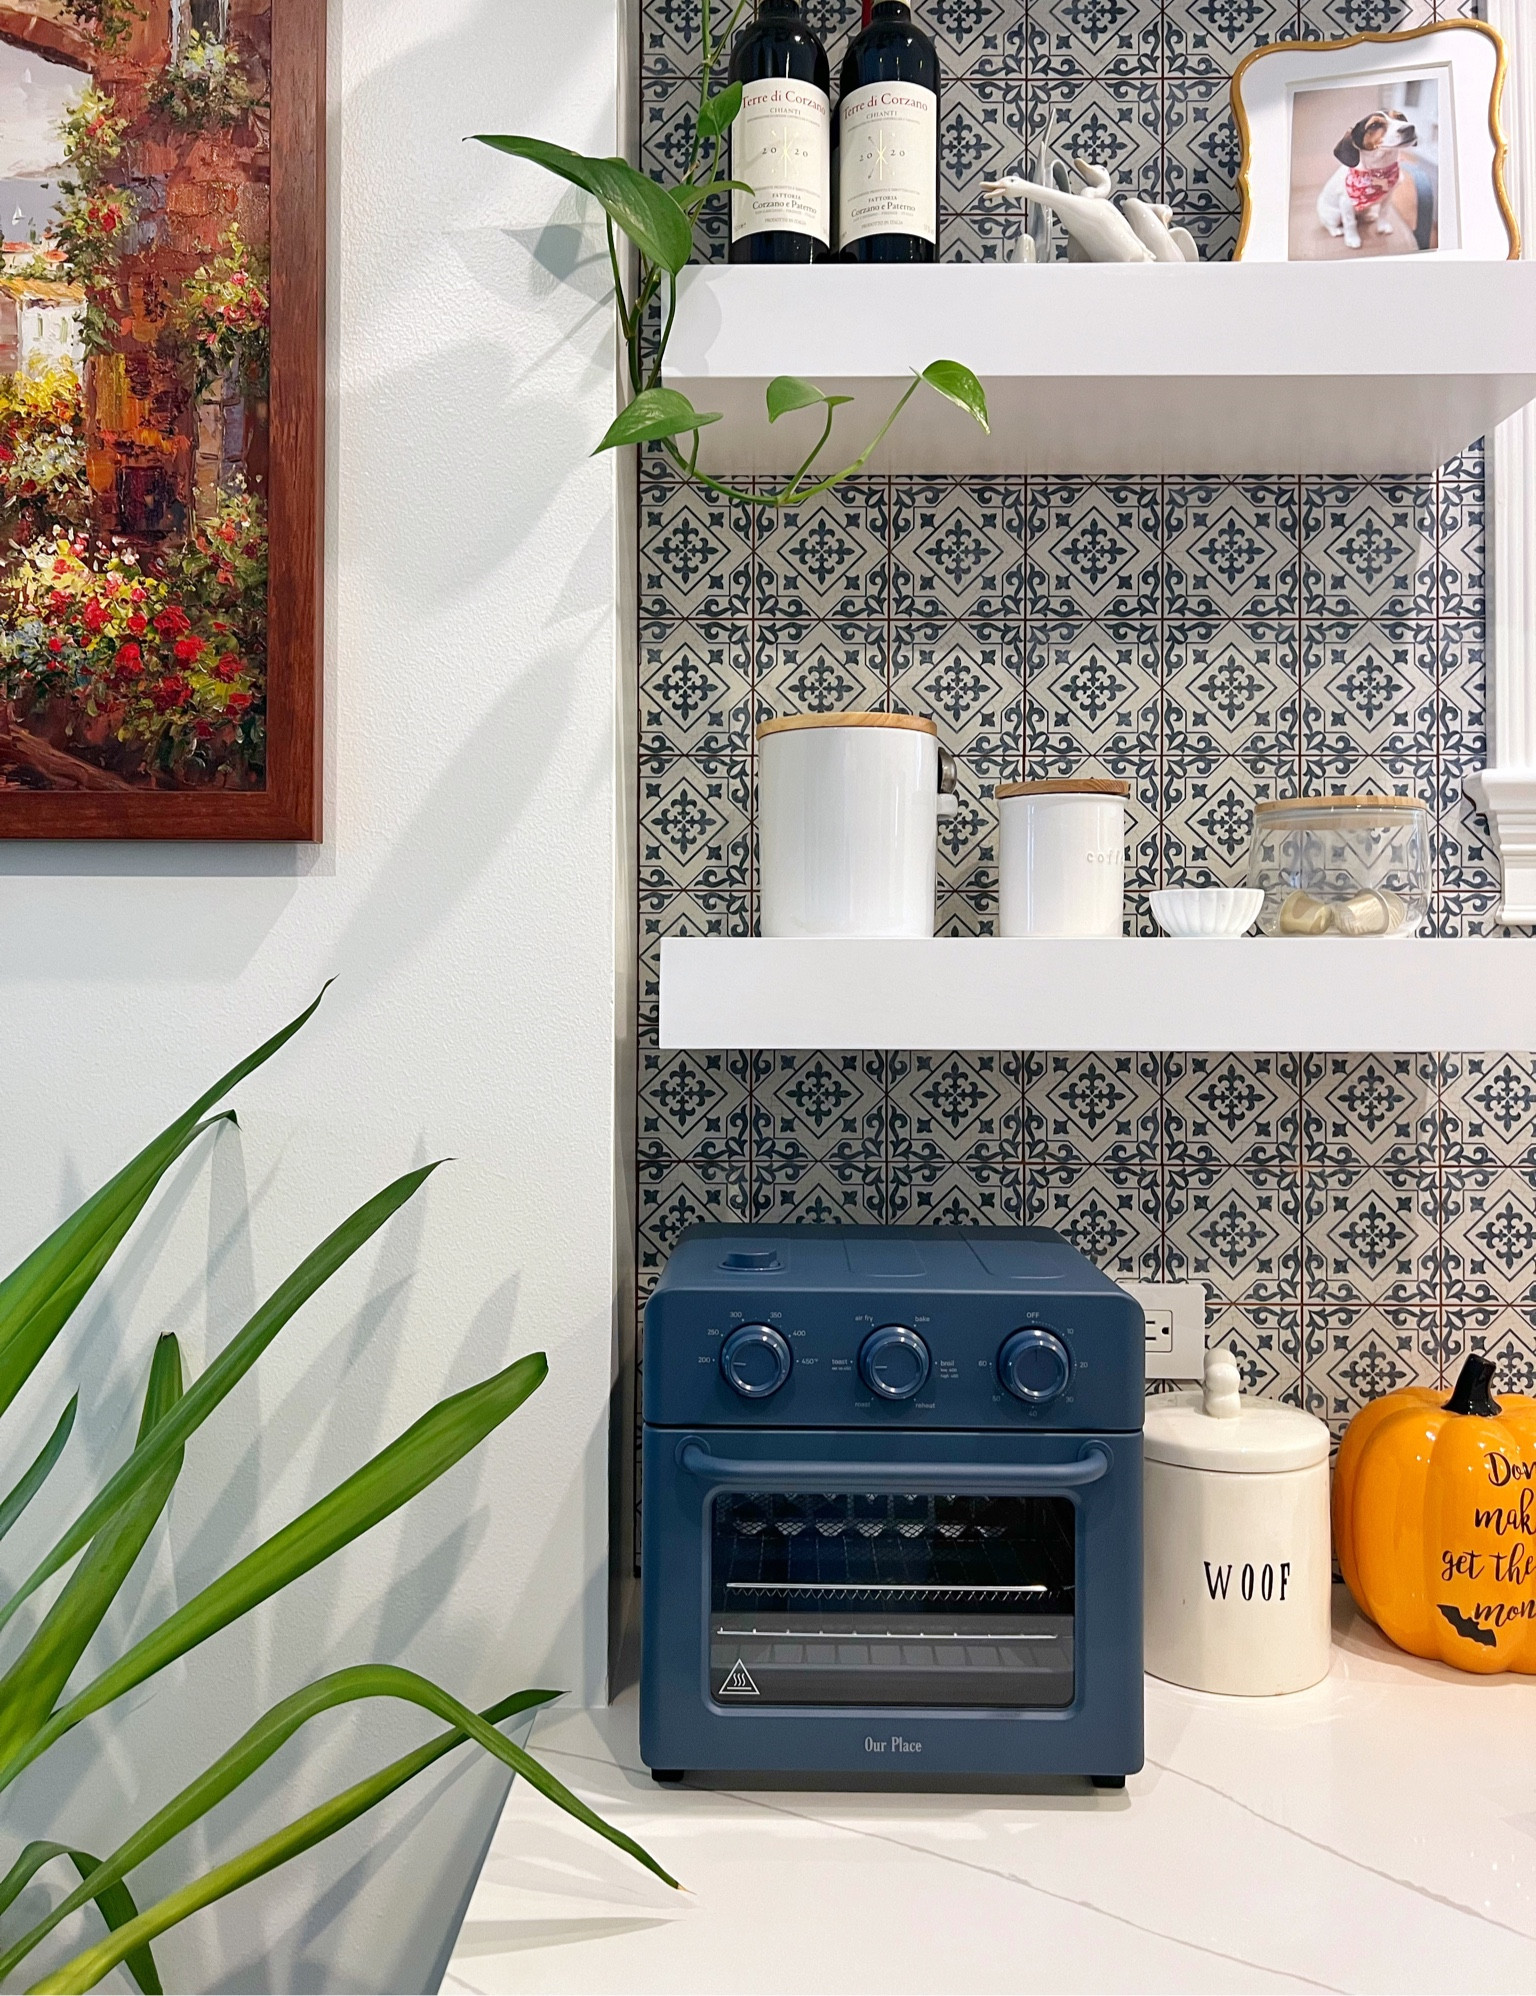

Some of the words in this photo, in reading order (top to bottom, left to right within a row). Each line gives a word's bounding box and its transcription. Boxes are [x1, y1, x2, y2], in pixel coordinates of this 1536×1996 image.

[742, 95, 768, 108] Terre
[771, 90, 782, 101] di
[785, 90, 826, 116] Corzano
[770, 107, 801, 115] CHIANTI
[844, 102, 865, 119] Terre
[867, 95, 877, 107] di
[881, 93, 928, 111] Corzano
[866, 110, 898, 119] CHIANTI
[752, 200, 785, 210] Corzano
[851, 204, 880, 217] Corzano
[887, 201, 916, 212] Paterno
[864, 1314, 874, 1323] fry
[1026, 1311, 1040, 1319] OFF
[1441, 1550, 1485, 1582] get
[1203, 1560, 1291, 1601] WOOF
[864, 1736, 887, 1752] Our
[891, 1736, 923, 1752] Place
